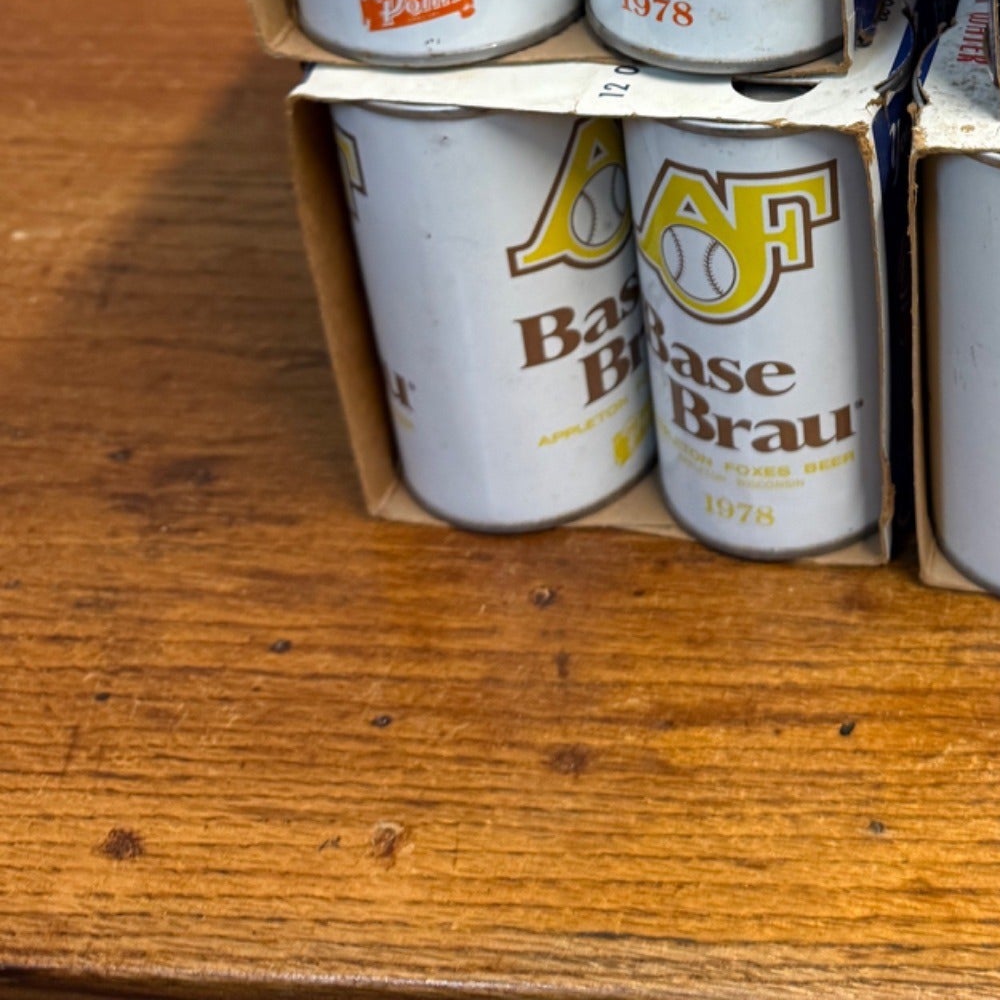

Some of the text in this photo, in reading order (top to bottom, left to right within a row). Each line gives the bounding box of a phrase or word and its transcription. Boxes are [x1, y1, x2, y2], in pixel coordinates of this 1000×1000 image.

[599, 82, 630, 97] 12
[513, 273, 641, 370] Bas
[724, 461, 791, 478] FOXES
[804, 450, 856, 475] BEER
[703, 492, 776, 527] 1978
